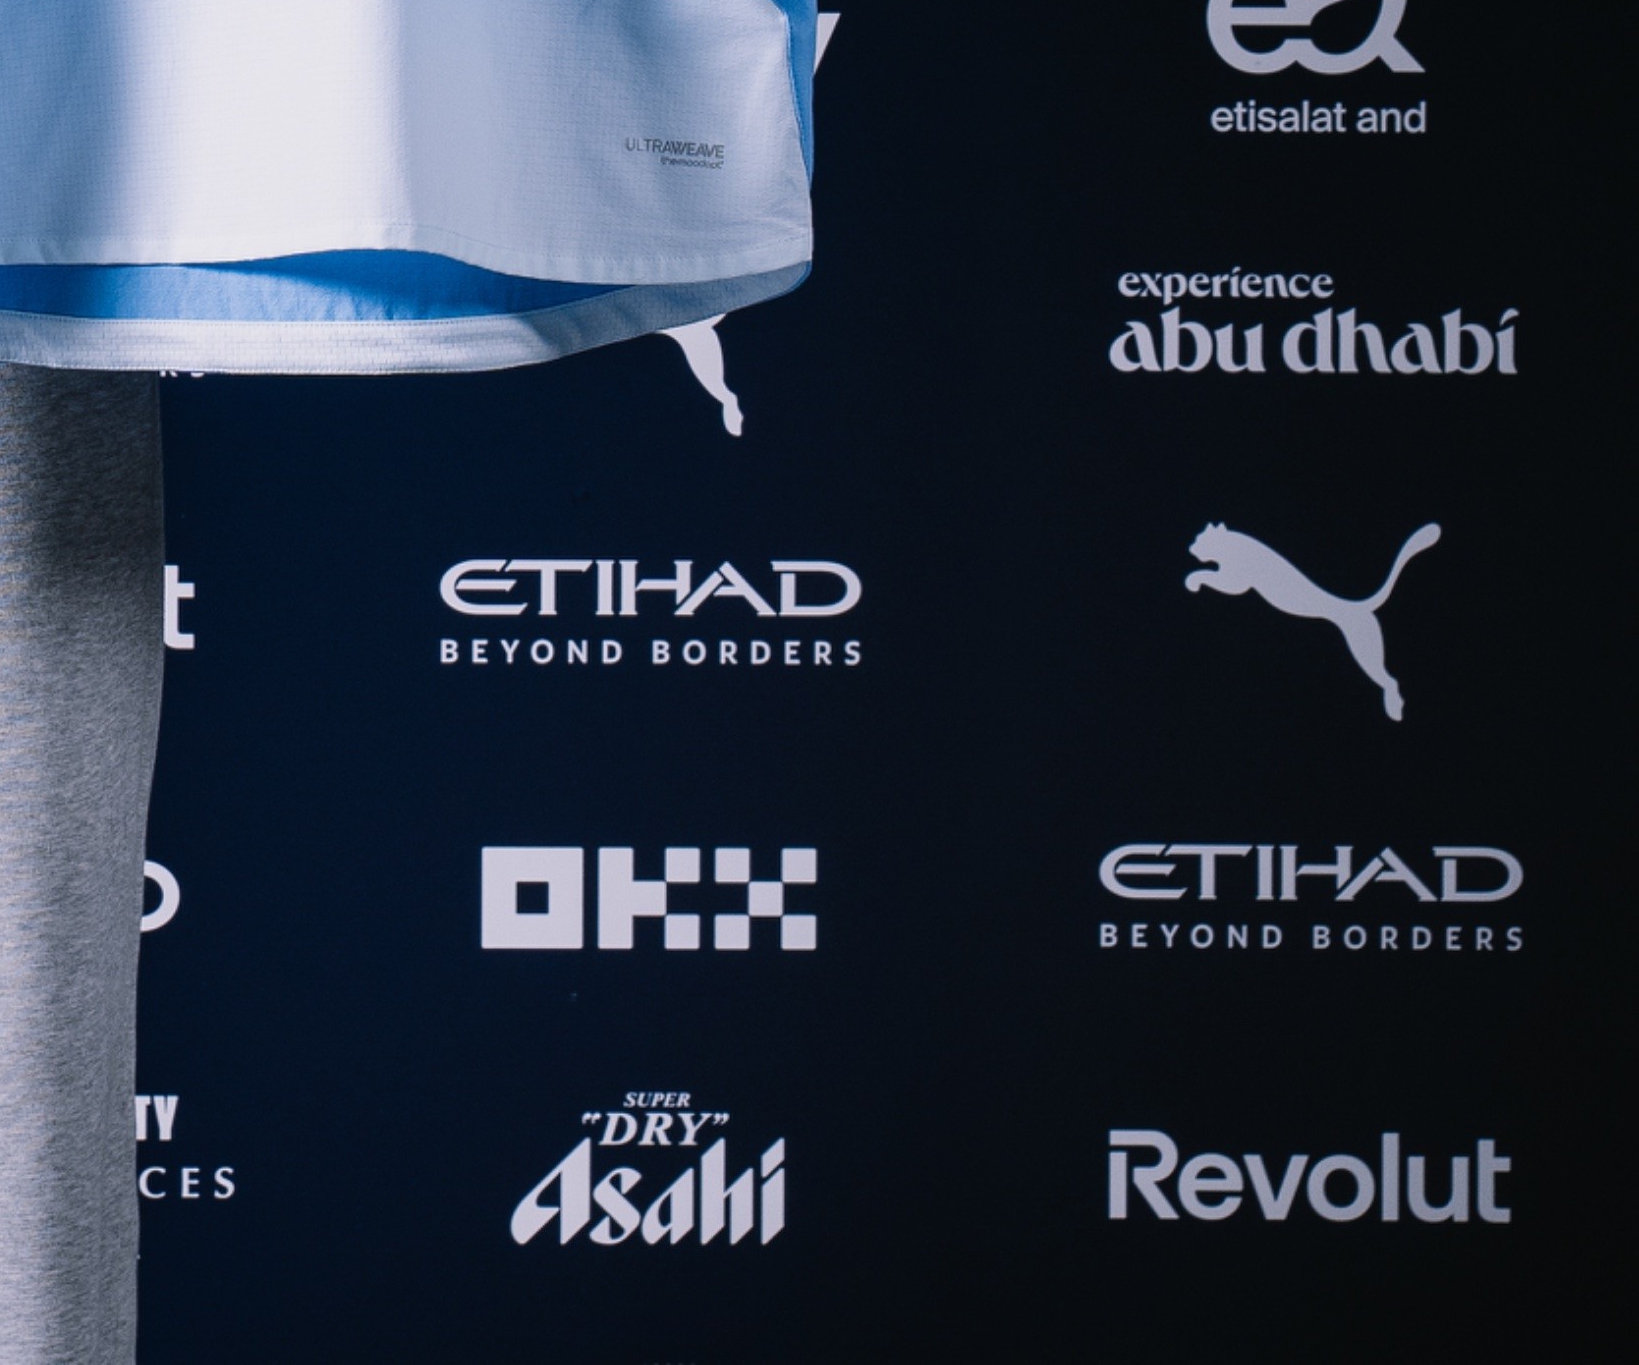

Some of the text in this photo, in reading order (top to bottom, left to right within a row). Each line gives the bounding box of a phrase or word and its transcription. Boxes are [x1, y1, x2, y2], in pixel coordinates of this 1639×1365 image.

[1211, 100, 1426, 133] etisalat and
[625, 137, 725, 159] ULTRAWEAVE
[1109, 307, 1266, 373] abu
[440, 559, 862, 617] ETIHAD
[440, 639, 861, 666] BEYOND BORDERS
[481, 846, 817, 951] OKX
[1099, 844, 1523, 902] ETIHAD
[1100, 924, 1522, 951] BEYOND BORDERS
[133, 1095, 178, 1139] TY
[623, 1092, 691, 1108] SUPER
[510, 1137, 785, 1245] Asahi
[1109, 1130, 1511, 1223] Revolut
